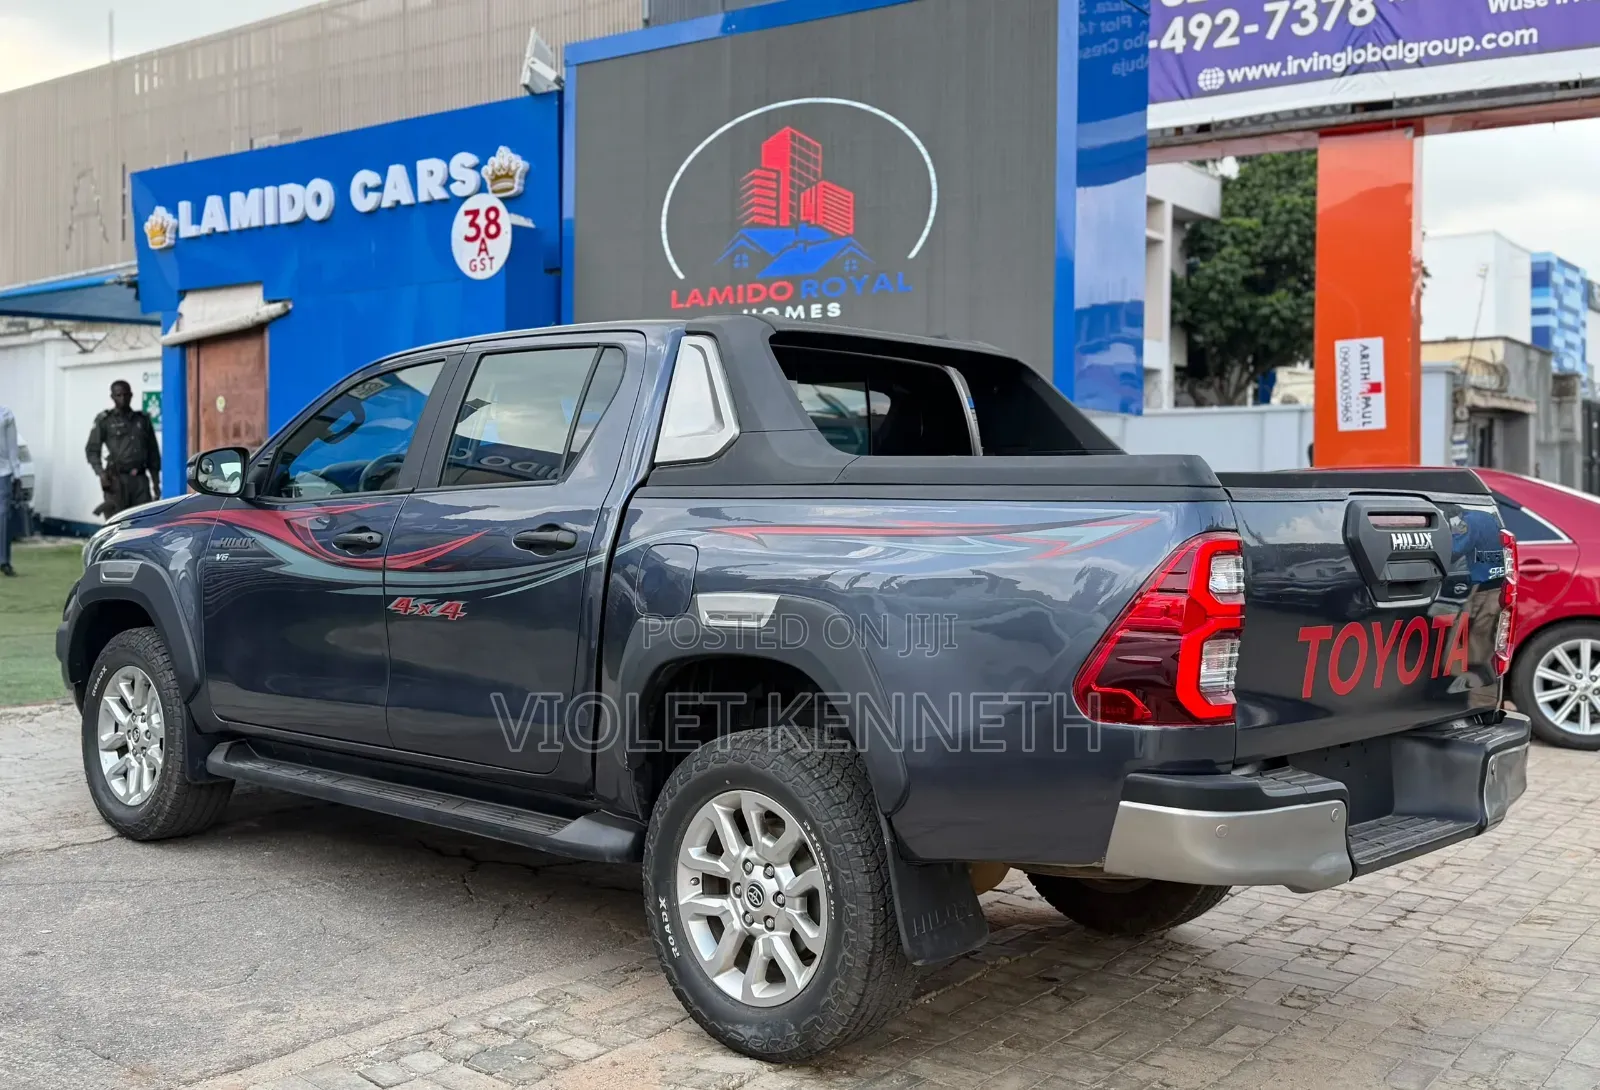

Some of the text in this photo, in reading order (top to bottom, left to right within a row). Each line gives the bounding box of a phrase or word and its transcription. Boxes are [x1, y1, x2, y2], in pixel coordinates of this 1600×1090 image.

[1227, 27, 1538, 84] www.irvinglobalgroup.com
[178, 152, 480, 239] LAMIDO CARS
[463, 206, 501, 243] 38
[469, 256, 495, 273] GST
[477, 237, 490, 257] A
[670, 272, 913, 309] LAMIDO ROYAL
[743, 302, 841, 320] MES
[1360, 343, 1372, 428] ARITH PAUL
[215, 553, 230, 562] V6
[1391, 532, 1433, 548] HILUX
[388, 597, 468, 620] 4x4
[1298, 612, 1470, 698] TOYOTA
[658, 895, 681, 958] ROADX
